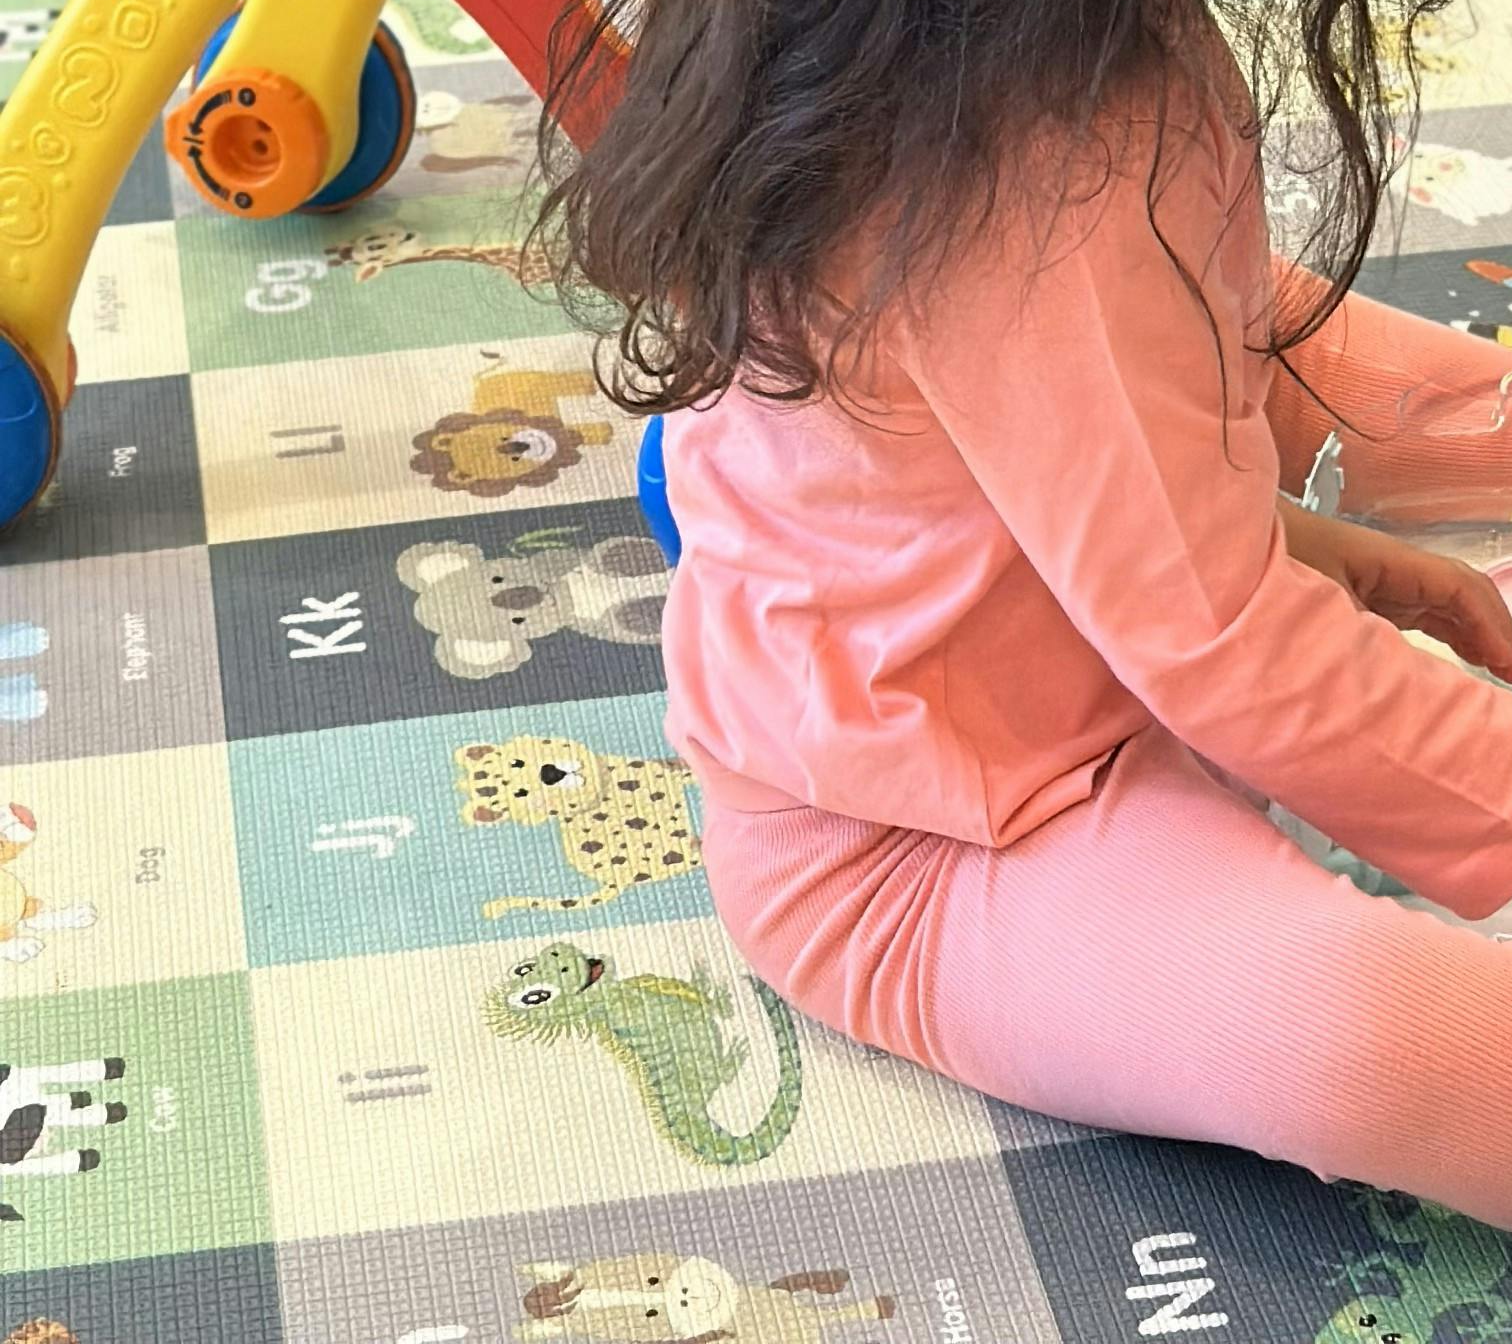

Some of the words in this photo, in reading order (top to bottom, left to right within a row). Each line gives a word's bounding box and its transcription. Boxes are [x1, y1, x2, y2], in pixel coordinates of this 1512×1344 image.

[244, 258, 328, 314] Gg
[108, 445, 137, 478] Frog
[279, 591, 367, 660] Kk
[312, 814, 416, 859] Jj
[135, 846, 167, 885] Dog
[1125, 1231, 1230, 1337] Nn
